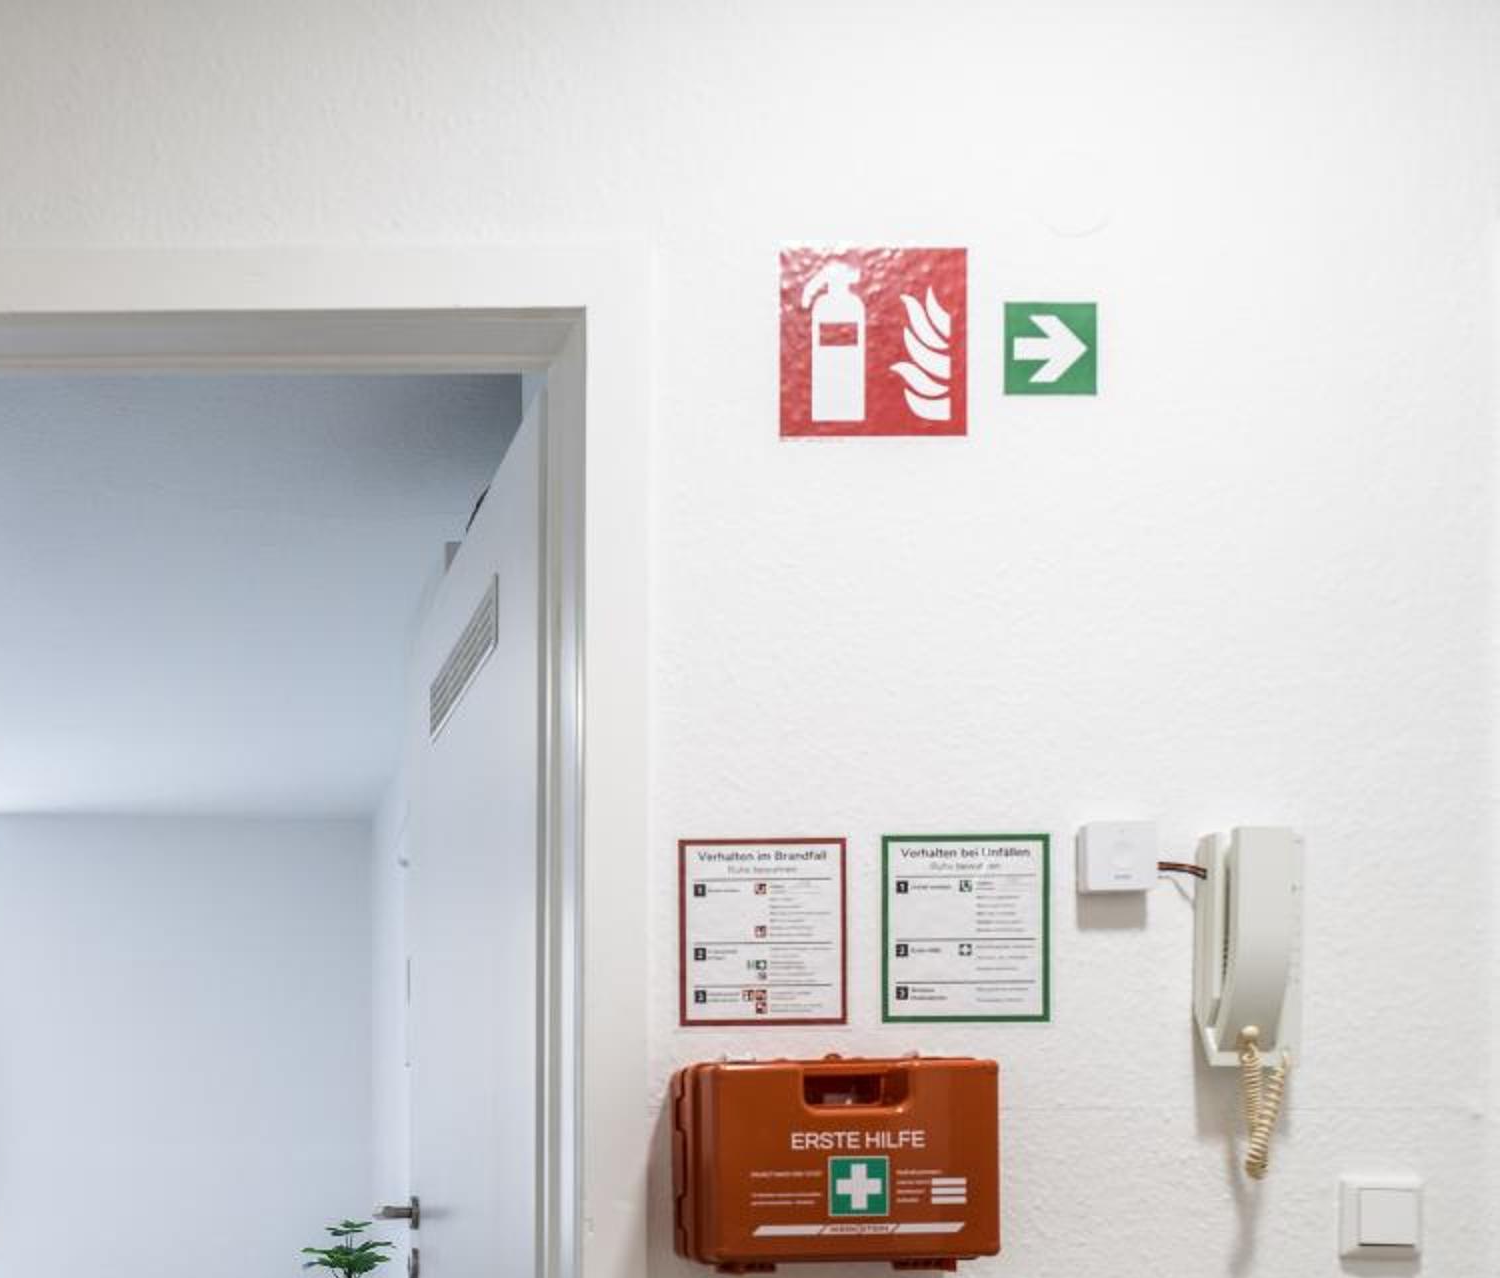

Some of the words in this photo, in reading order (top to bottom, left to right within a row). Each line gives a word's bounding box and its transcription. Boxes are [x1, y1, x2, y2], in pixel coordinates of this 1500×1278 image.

[698, 851, 754, 862] Verhalten
[757, 851, 772, 861] im
[774, 850, 827, 861] Brandfall
[901, 847, 957, 859] Verhalten
[961, 847, 979, 858] bei
[791, 1131, 860, 1149] ERSTE
[865, 1130, 926, 1148] HILFE
